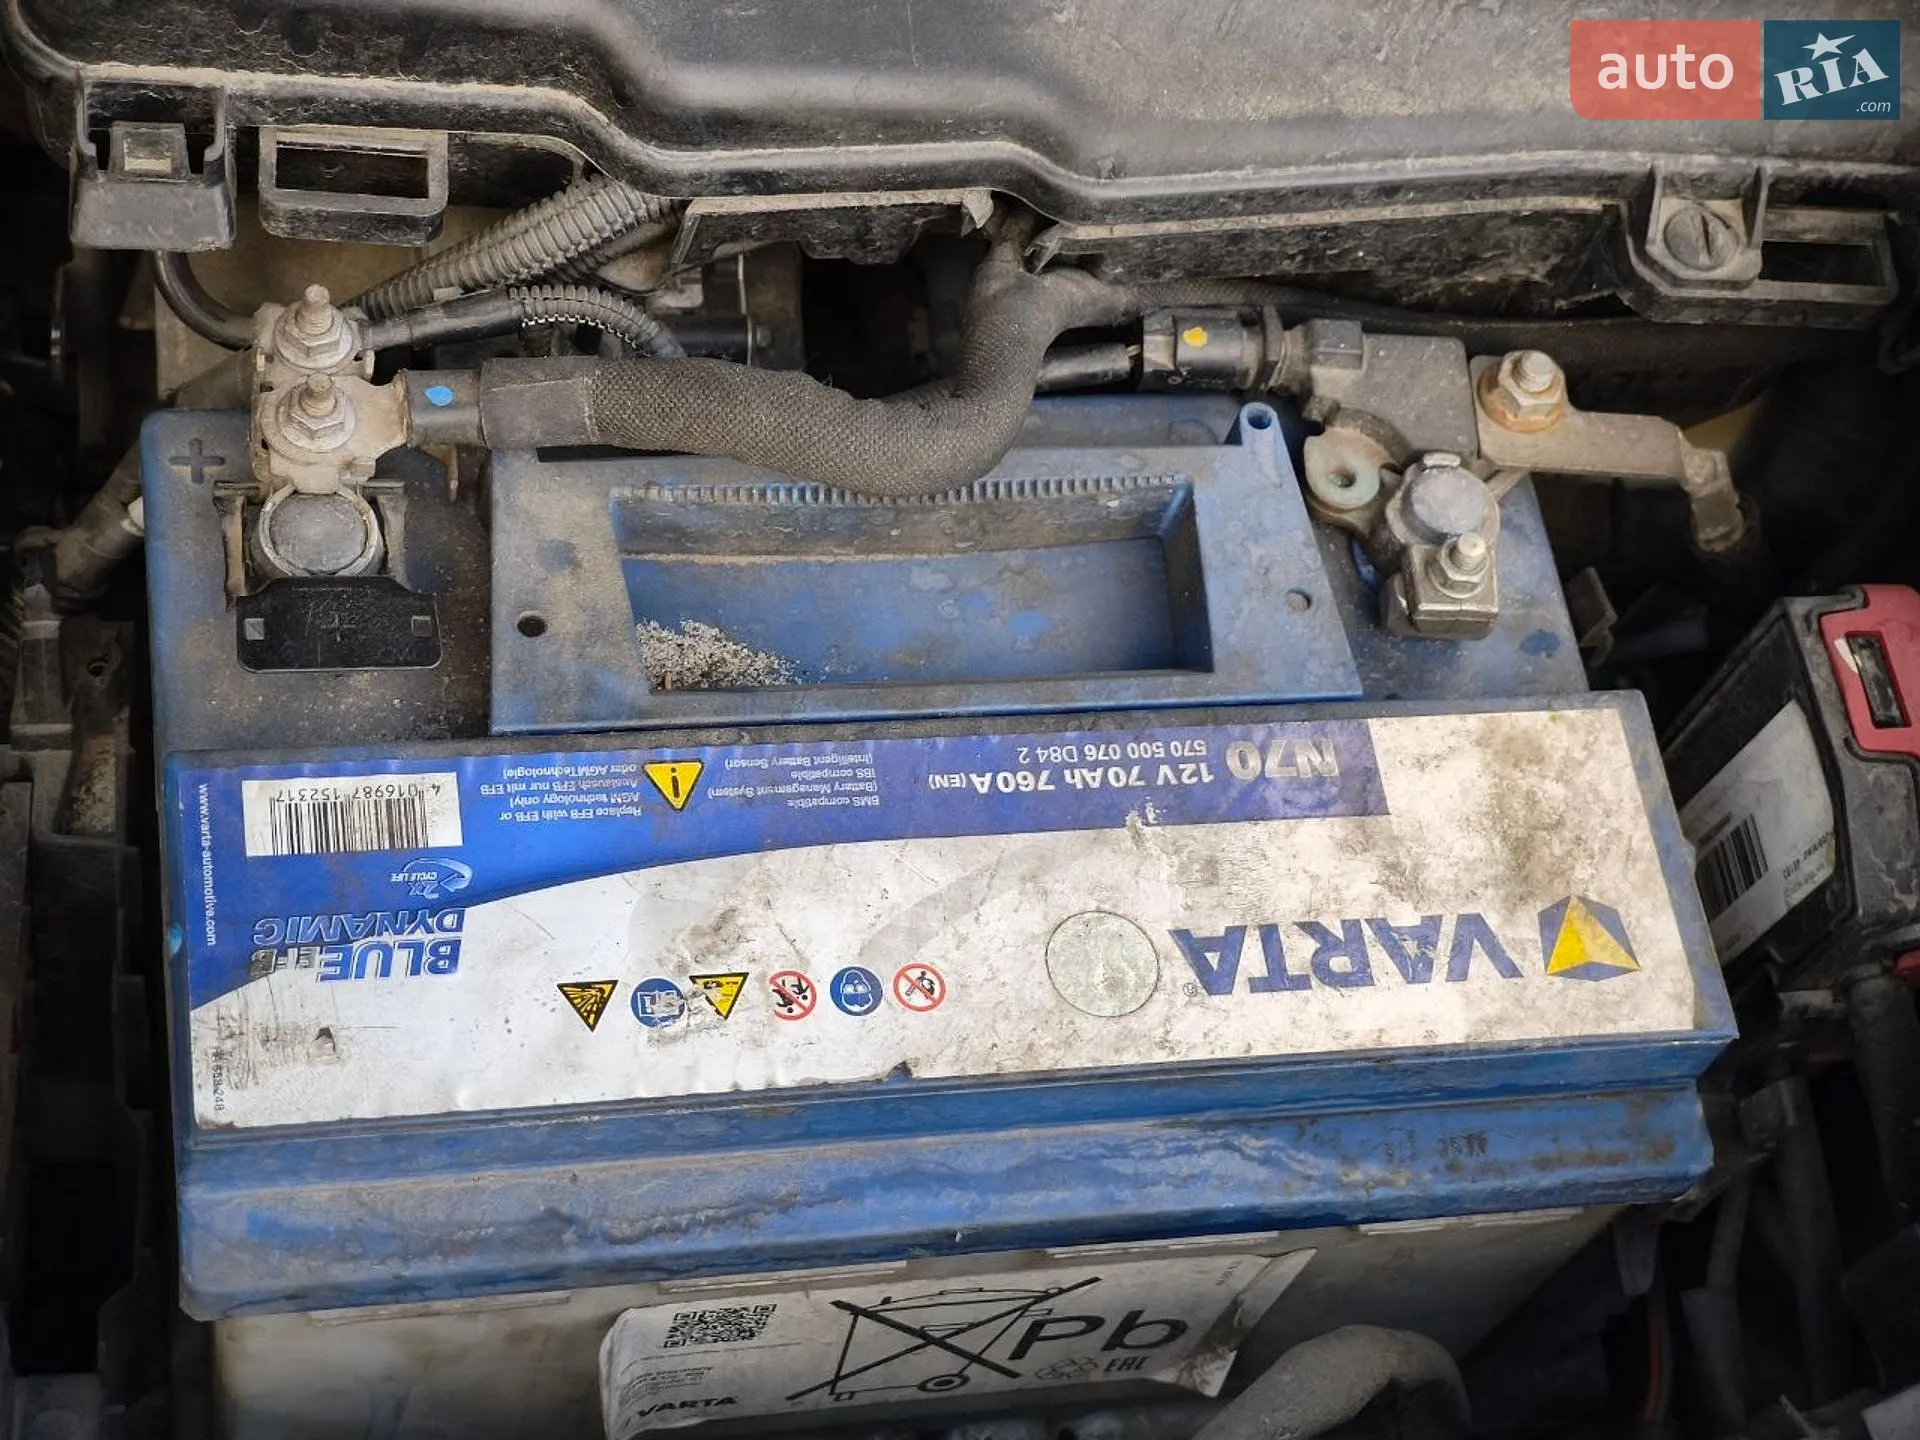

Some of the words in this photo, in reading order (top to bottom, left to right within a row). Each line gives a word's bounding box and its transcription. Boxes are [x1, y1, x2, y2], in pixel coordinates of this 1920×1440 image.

[1016, 746, 1031, 764] 2
[1036, 744, 1079, 764] D84
[1084, 743, 1121, 762] 076
[1126, 741, 1164, 760] 500
[1169, 739, 1208, 758] 570
[725, 757, 769, 771] Sensor)
[771, 755, 811, 768] Battery
[813, 752, 873, 766] (Intelligent
[1225, 739, 1340, 781] N70
[610, 763, 637, 775] oder
[790, 768, 853, 781] compatible
[855, 768, 876, 779] IBS
[1156, 762, 1214, 786] 12V
[352, 784, 418, 800] 016987
[430, 783, 440, 796] 4
[479, 784, 504, 795] EFB
[506, 783, 526, 793] mit
[530, 782, 550, 792] nur
[552, 781, 576, 791] EFB
[707, 785, 754, 799] System)
[755, 781, 831, 797] Management
[833, 780, 878, 794] (Battery
[276, 787, 341, 802] 152317
[509, 795, 540, 808] only!
[543, 792, 608, 806] technology
[610, 791, 640, 803] AGM
[853, 795, 880, 807] BMS
[787, 795, 850, 809] compatible
[499, 812, 513, 821] or
[514, 811, 539, 822] EFB
[542, 809, 568, 820] with
[570, 808, 594, 819] EFB
[595, 805, 642, 817] Replace
[198, 782, 217, 947] www.varta-automotive.com
[390, 872, 409, 883] LIFE
[410, 871, 438, 881] CYCLE
[407, 880, 440, 899] 2x
[251, 908, 466, 945] DYNAMIC
[249, 947, 317, 977] EFB
[317, 939, 462, 982] BLUE
[1166, 913, 1524, 997] VARTA
[1008, 1309, 1188, 1360] Pb
[637, 1396, 738, 1417] VARTA
